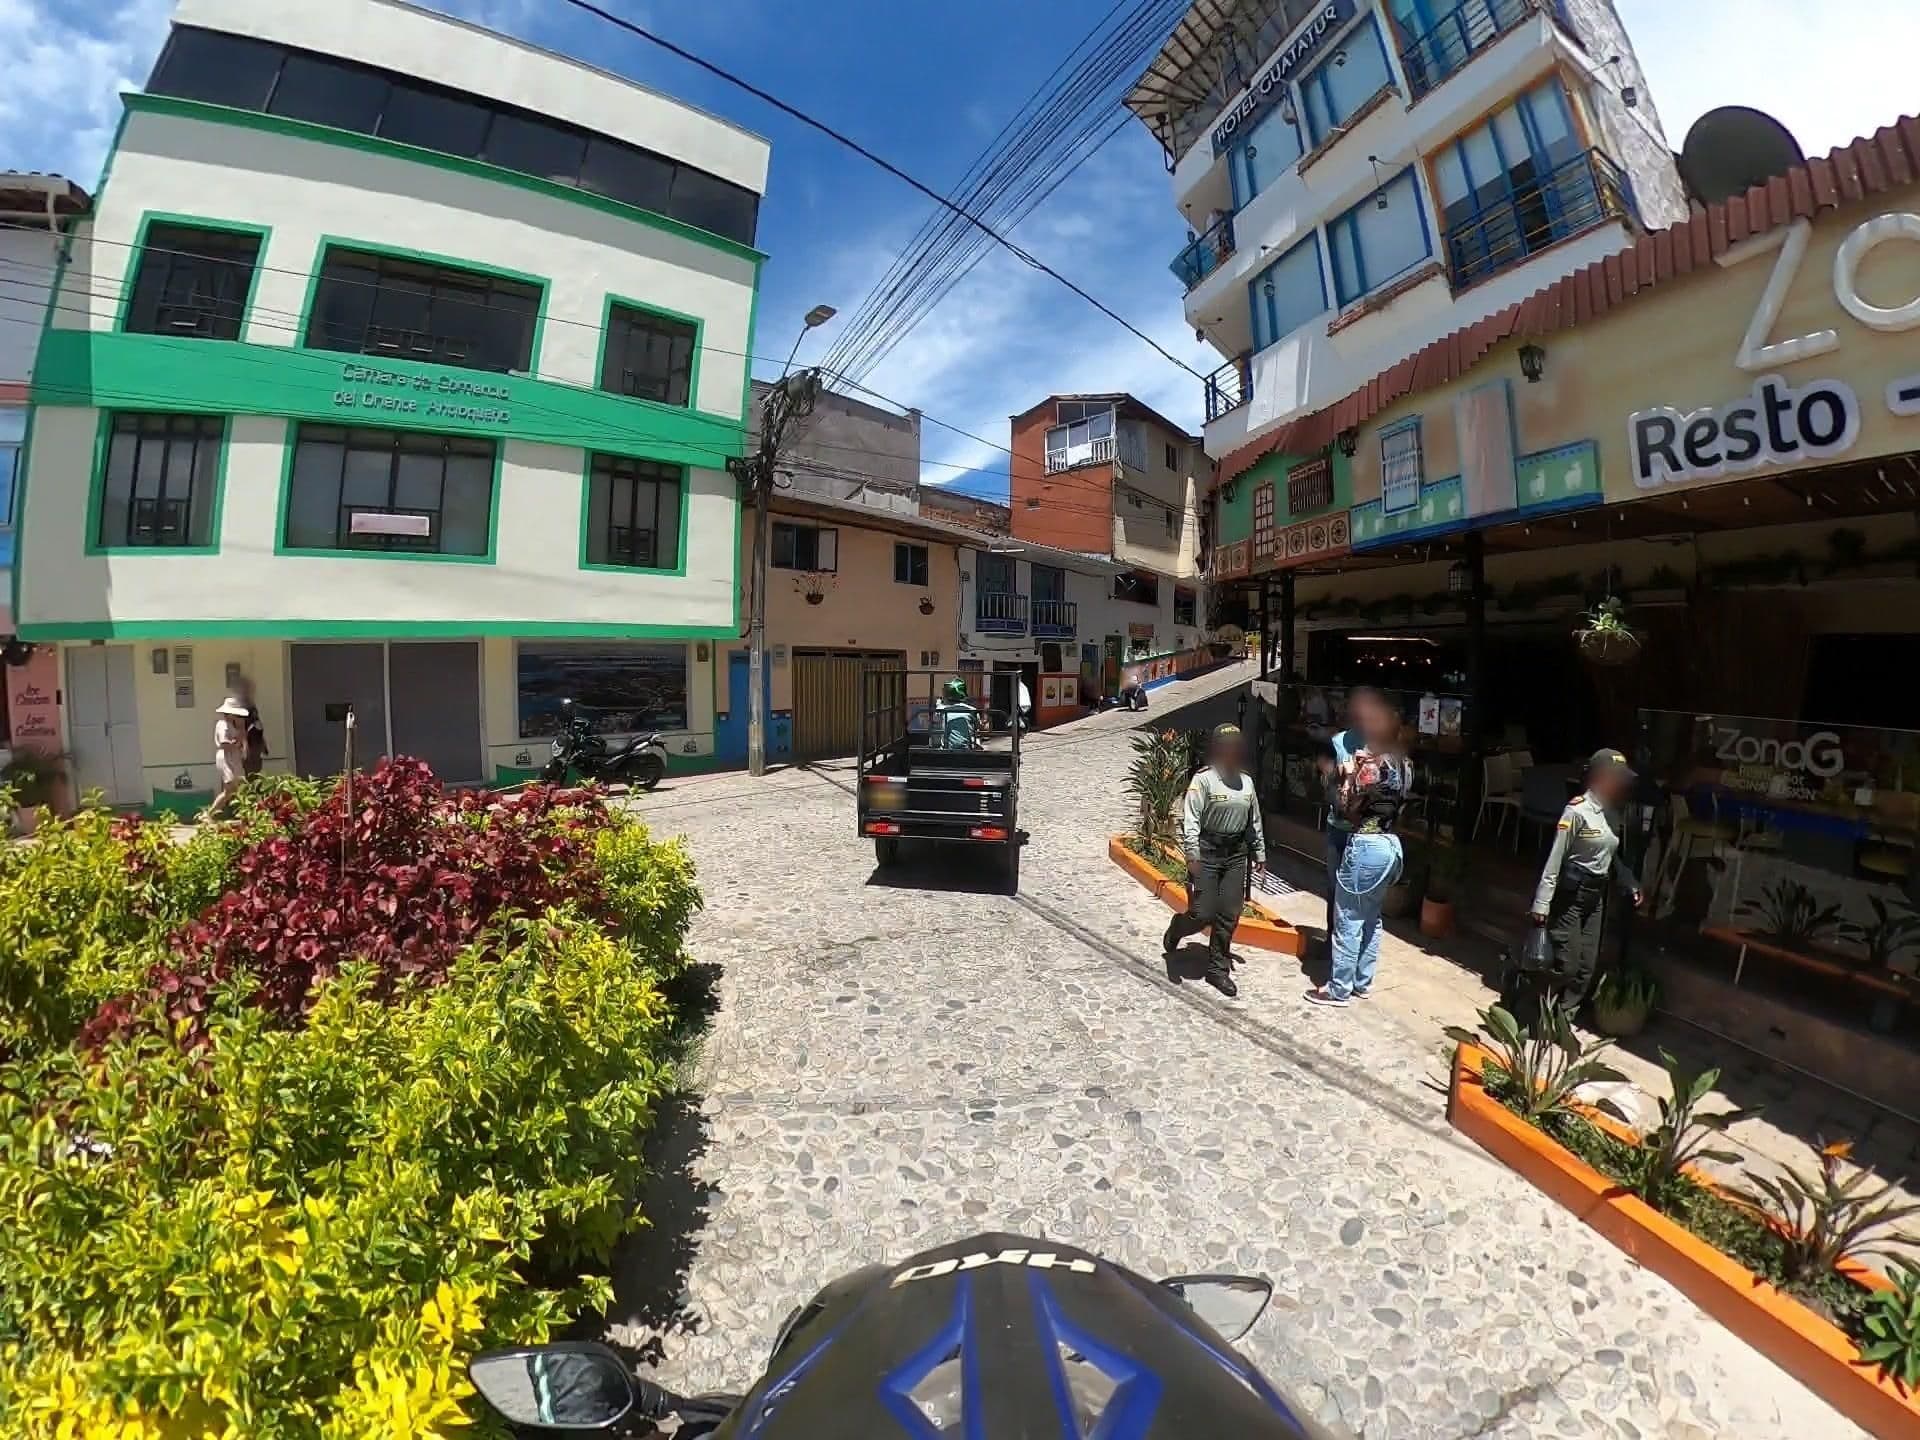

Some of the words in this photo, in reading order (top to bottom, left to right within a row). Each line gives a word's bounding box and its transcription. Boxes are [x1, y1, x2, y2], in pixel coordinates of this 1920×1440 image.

[1216, 95, 1258, 143] HOTEL
[1260, 5, 1337, 95] GUATATUR
[333, 388, 357, 408] del
[438, 376, 510, 400] Comercio
[1635, 384, 1847, 478] Resto
